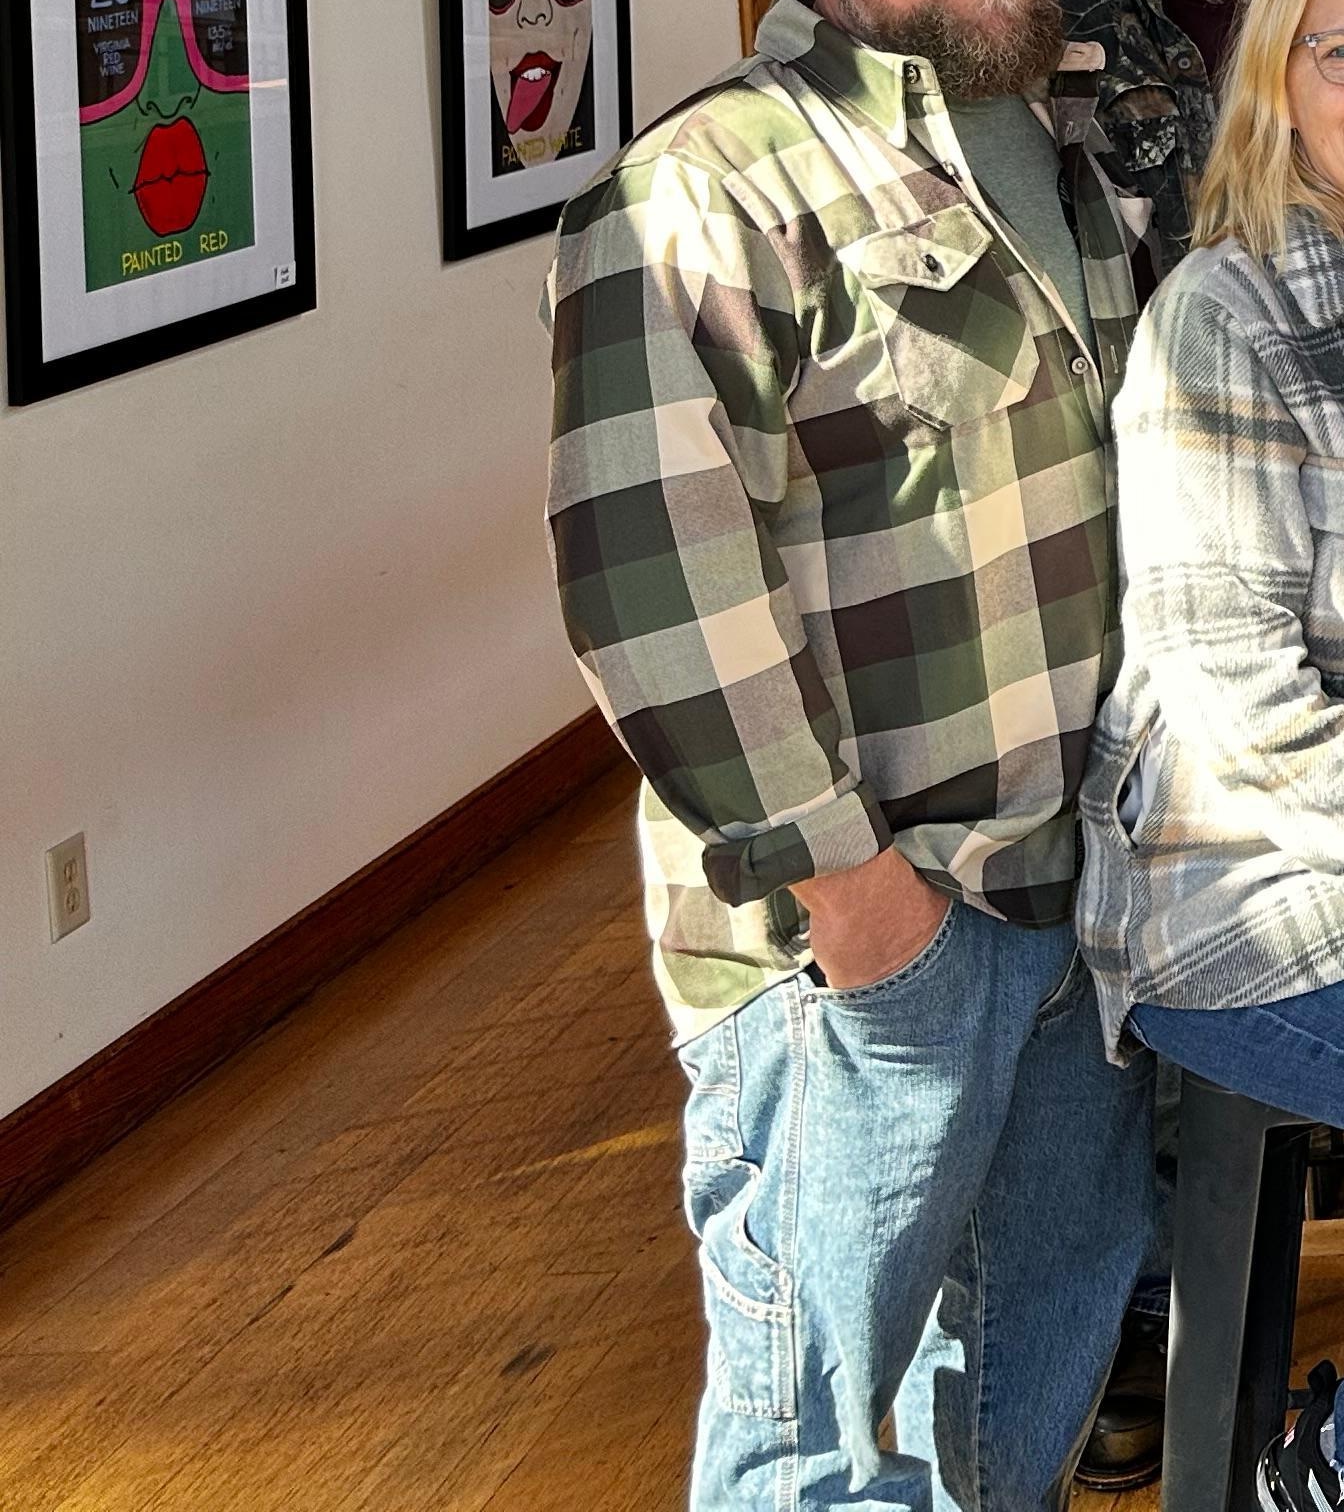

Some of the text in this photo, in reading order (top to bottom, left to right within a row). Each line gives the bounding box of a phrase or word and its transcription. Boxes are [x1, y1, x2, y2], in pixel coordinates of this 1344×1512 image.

[87, 10, 139, 34] NINETEEN
[122, 230, 229, 276] PAINTED RED
